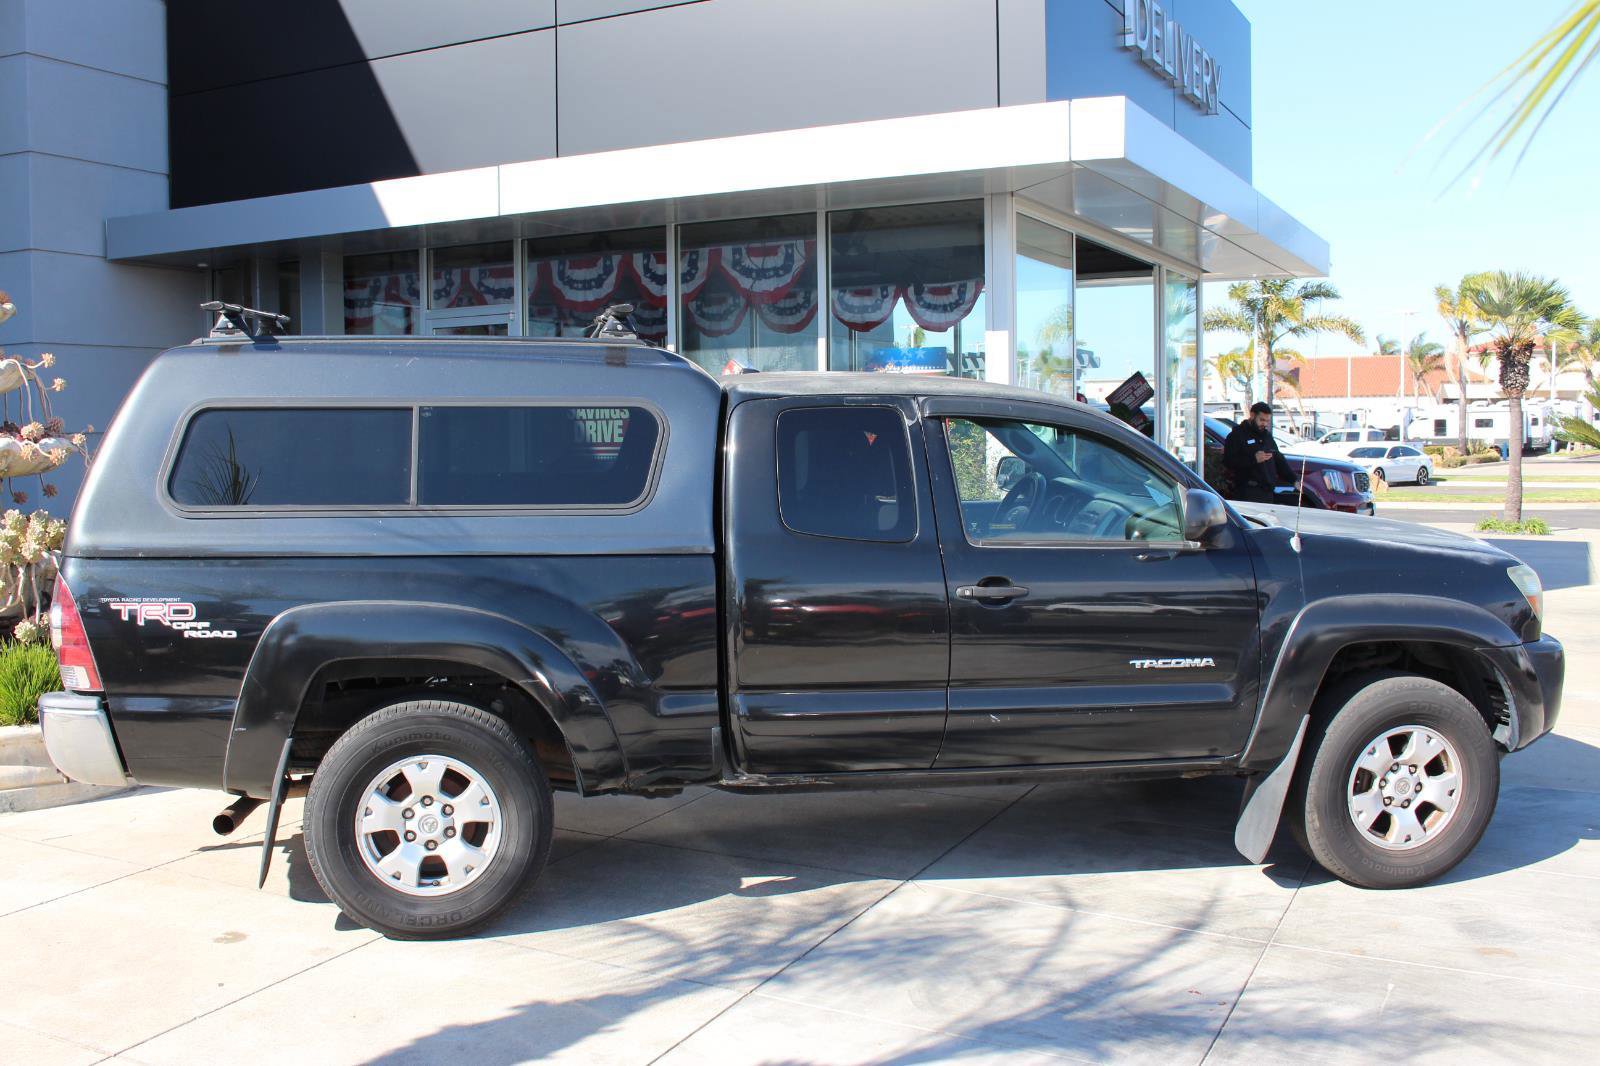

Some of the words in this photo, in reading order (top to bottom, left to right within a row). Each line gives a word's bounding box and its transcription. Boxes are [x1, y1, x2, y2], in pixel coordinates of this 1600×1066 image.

[574, 420, 624, 443] DRIVE
[110, 602, 197, 627] TRD
[172, 621, 211, 630] OFF
[183, 630, 238, 639] ROAD
[1129, 657, 1216, 669] TACOMA
